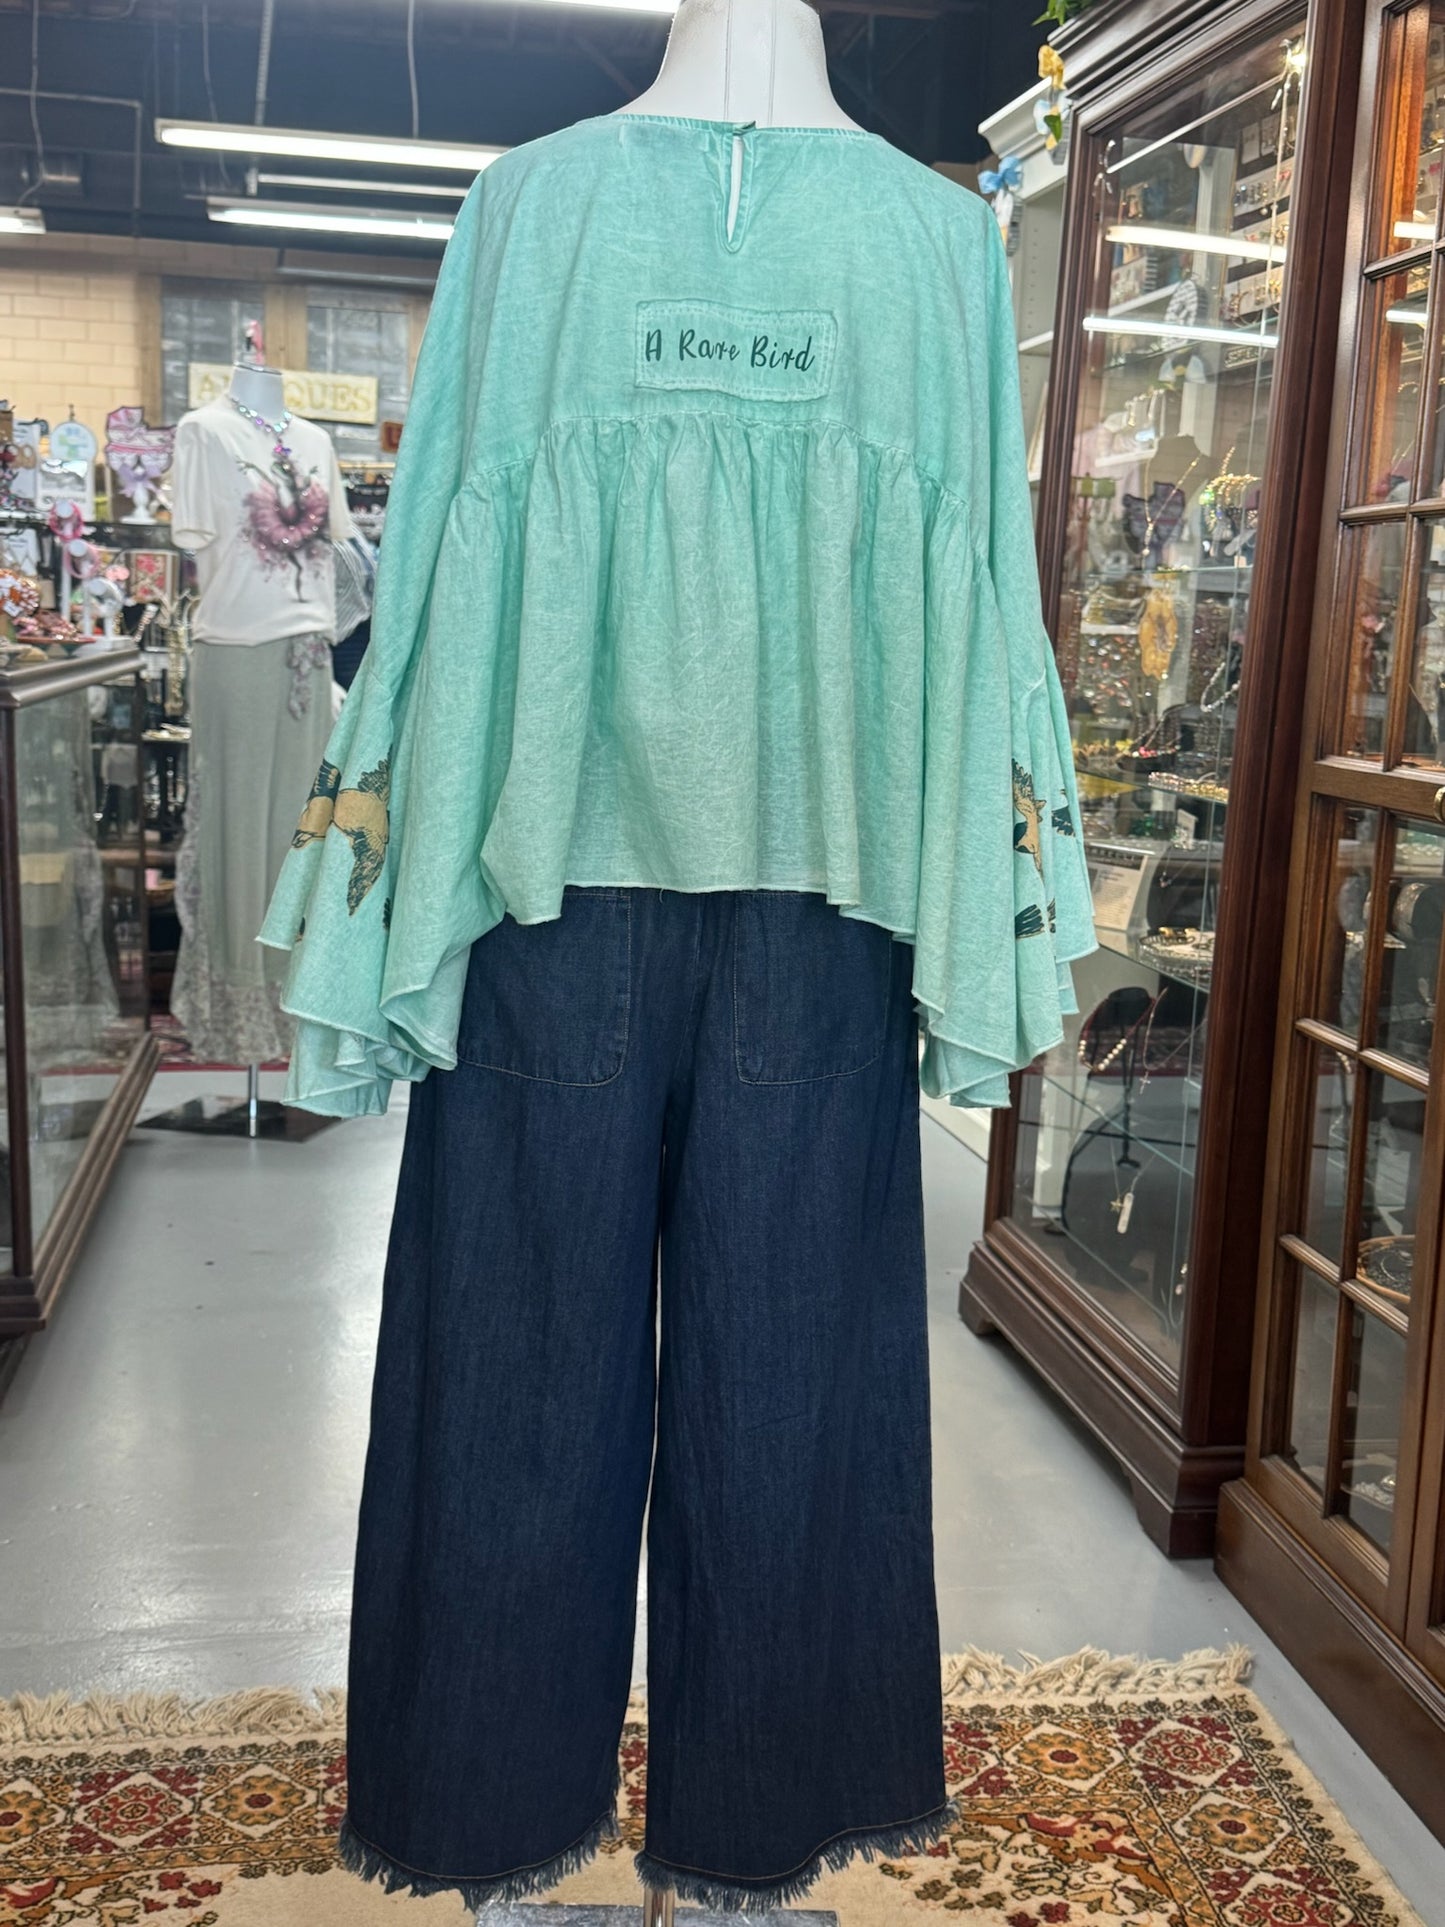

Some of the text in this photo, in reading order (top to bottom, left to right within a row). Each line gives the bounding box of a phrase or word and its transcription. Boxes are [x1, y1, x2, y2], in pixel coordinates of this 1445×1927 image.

[645, 329, 815, 372] A Rare Bird
[198, 373, 370, 412] AQUES
